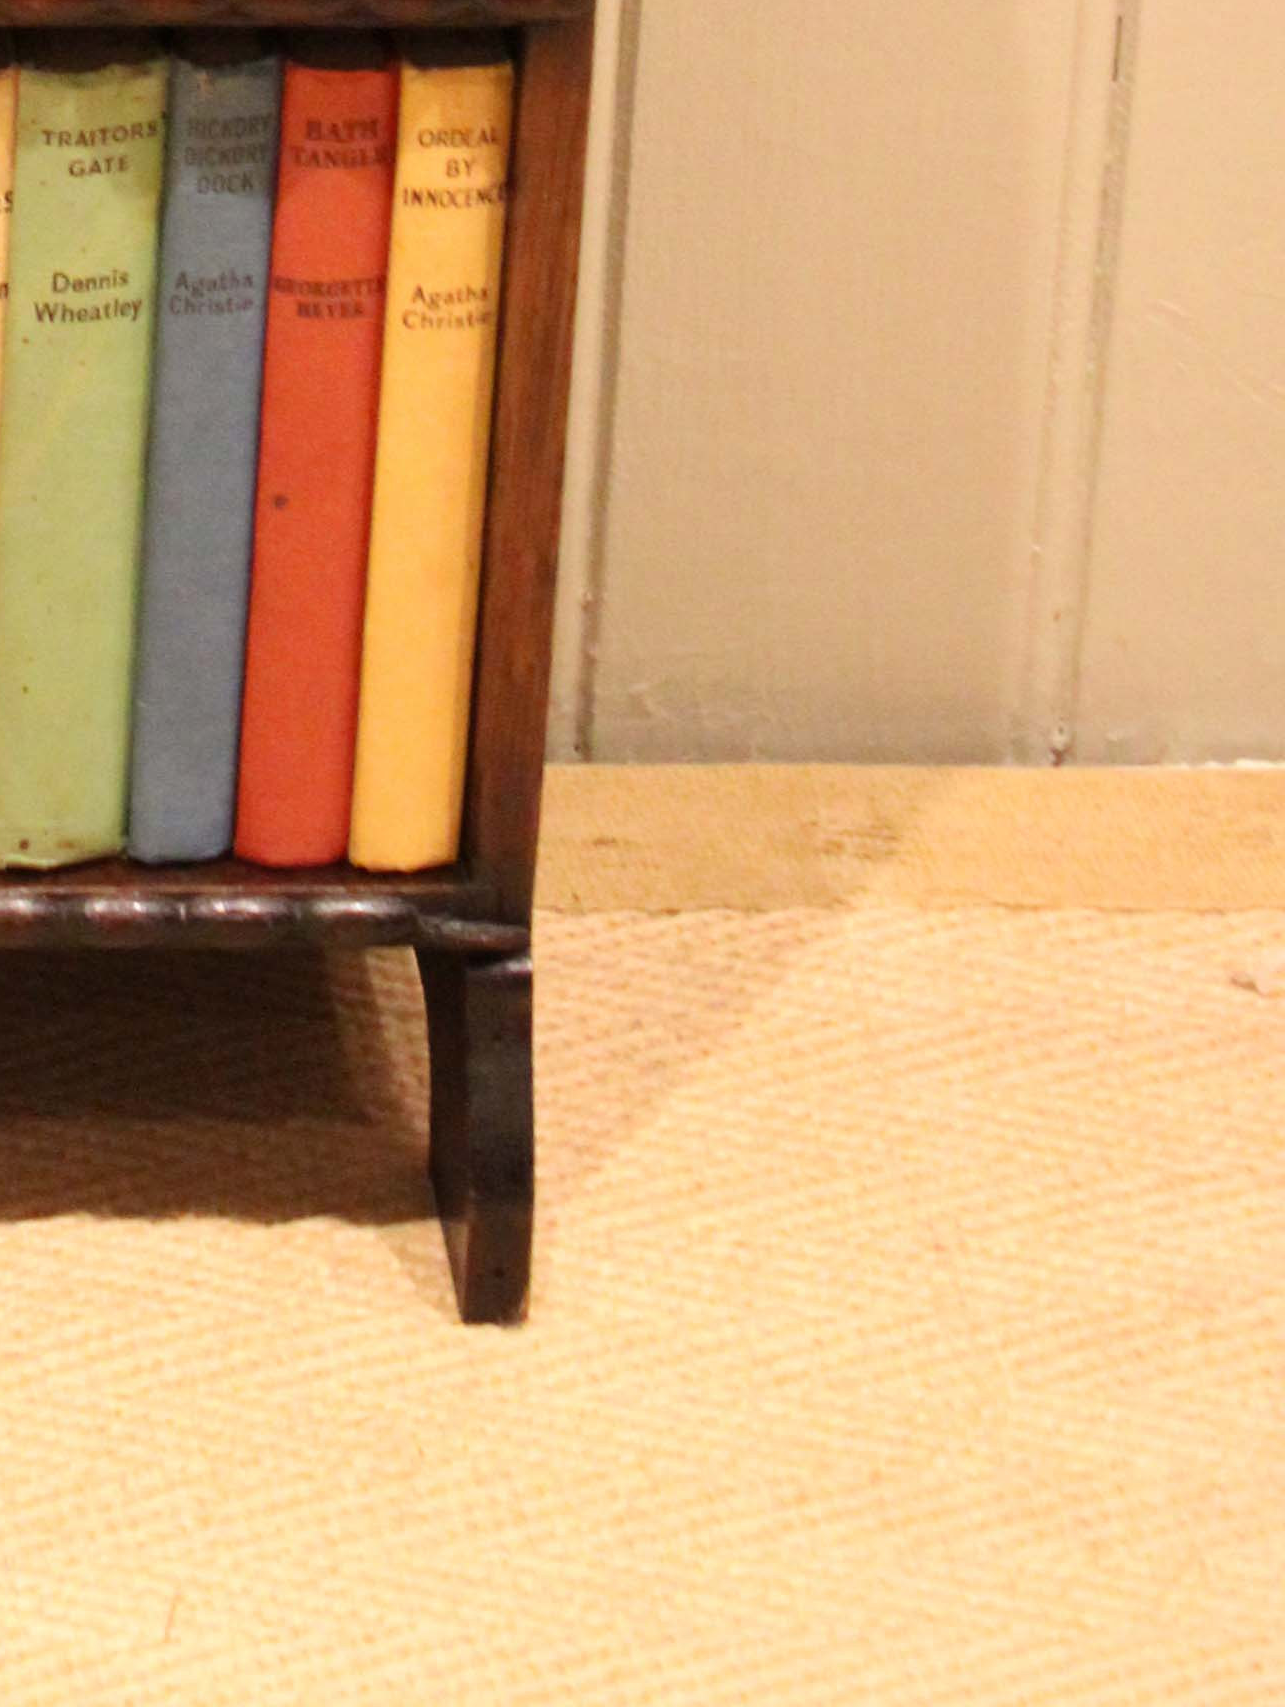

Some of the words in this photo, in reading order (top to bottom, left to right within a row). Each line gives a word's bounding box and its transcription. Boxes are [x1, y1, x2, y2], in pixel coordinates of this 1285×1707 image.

[68, 157, 129, 178] GATE
[53, 270, 129, 294] Dennis
[35, 297, 142, 324] Wheatley
